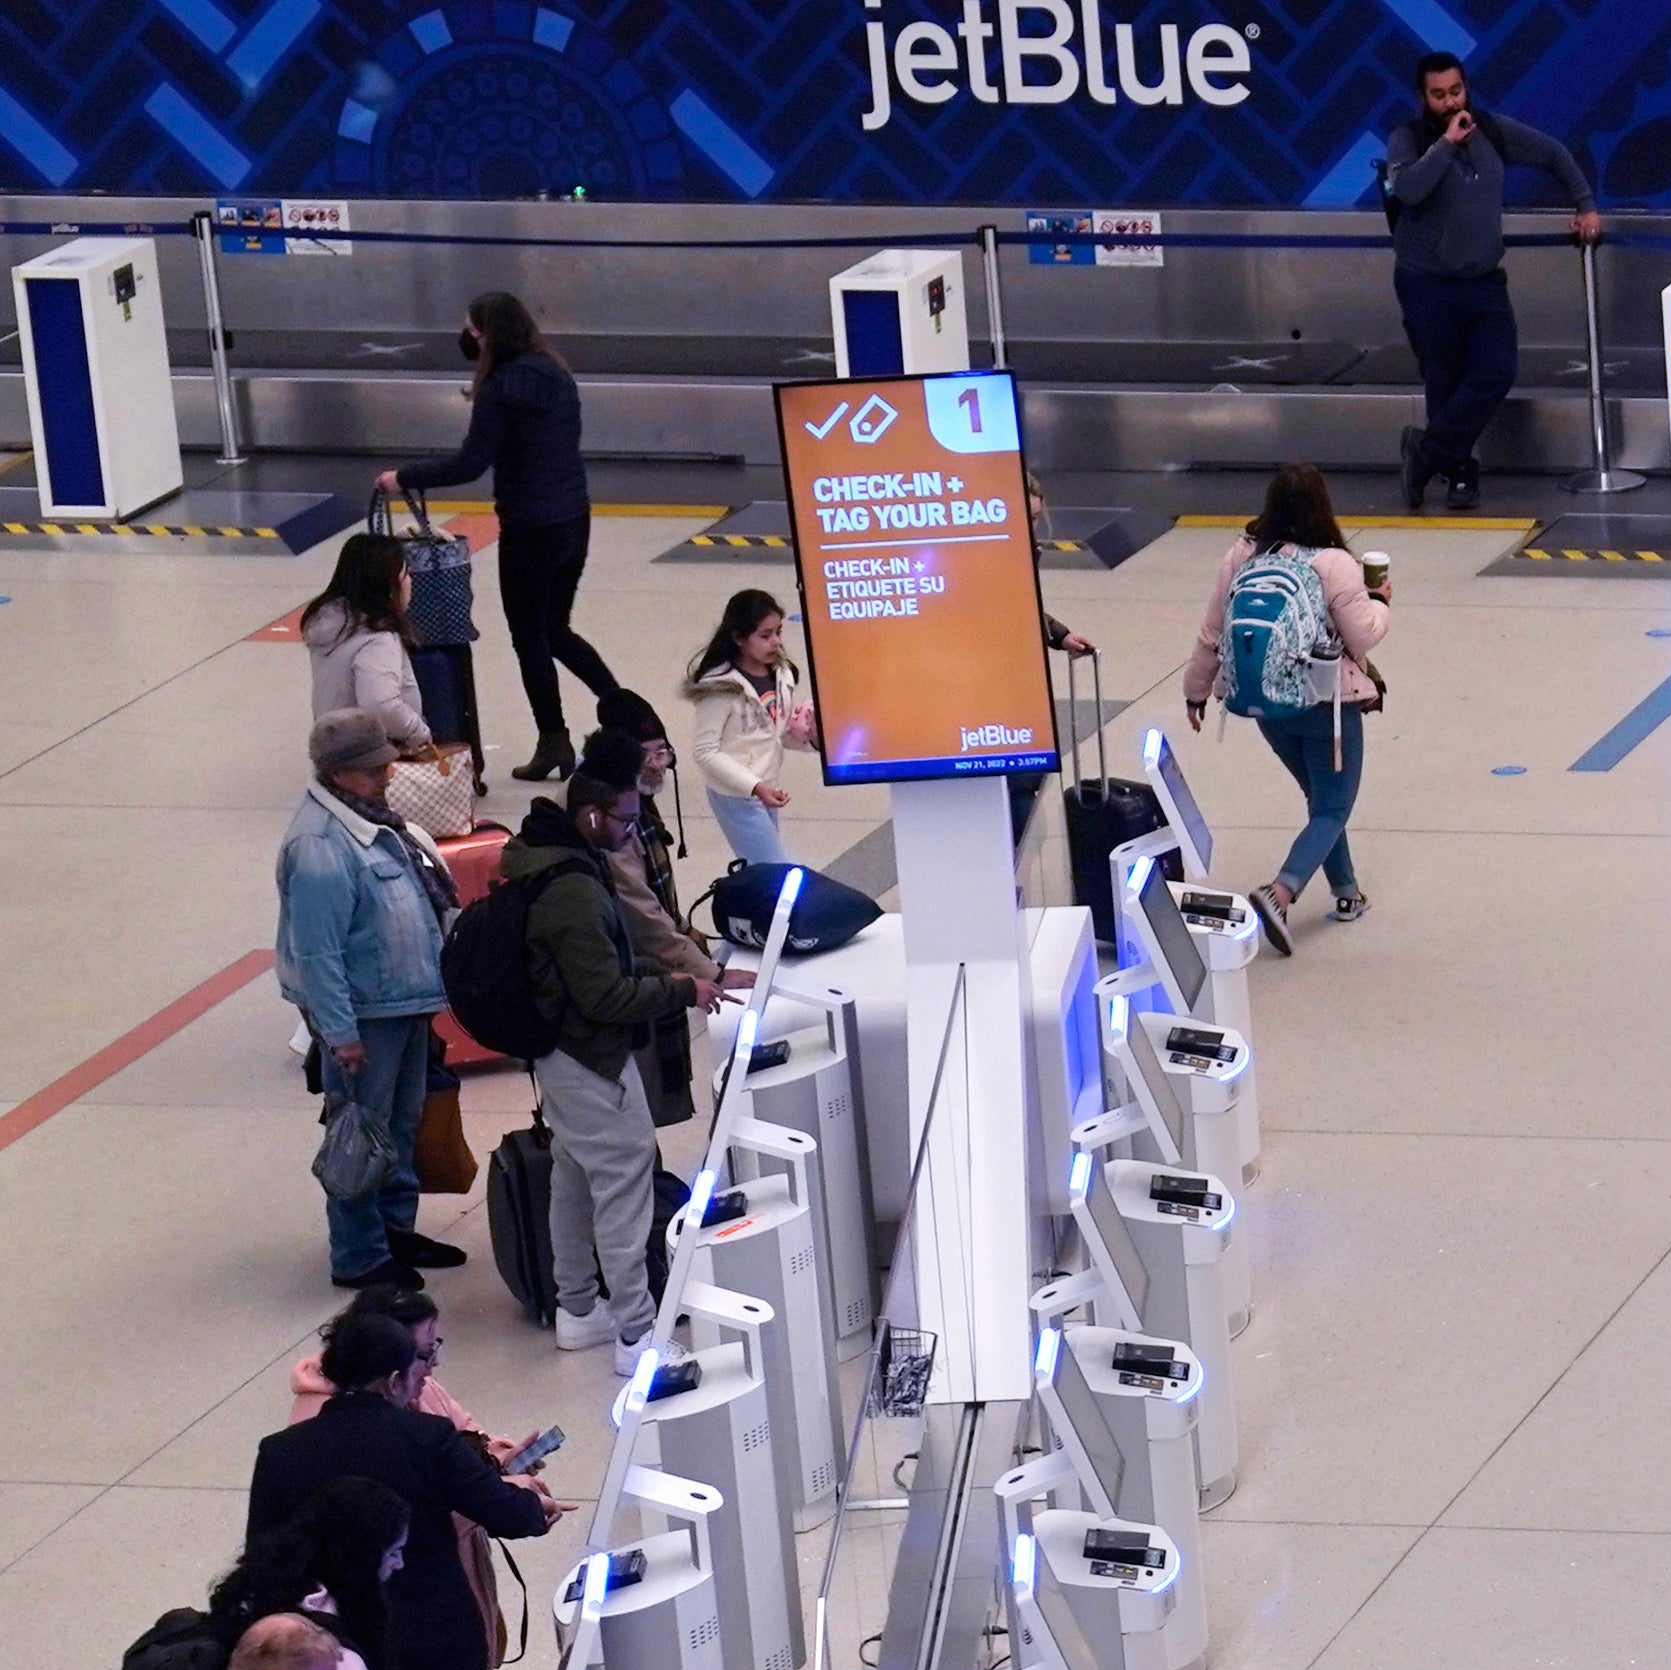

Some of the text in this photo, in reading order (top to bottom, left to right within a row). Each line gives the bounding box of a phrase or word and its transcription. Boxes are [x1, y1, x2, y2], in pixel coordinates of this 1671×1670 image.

[957, 387, 983, 434] 1
[812, 471, 943, 503] CHECK-IN
[816, 497, 1008, 534] TAG YOUR BAG
[822, 557, 910, 579] CHECK-IN
[825, 575, 946, 600] ETIQUETE SU
[828, 598, 919, 621] EQUIPAJE
[960, 723, 1032, 753] jetBlue
